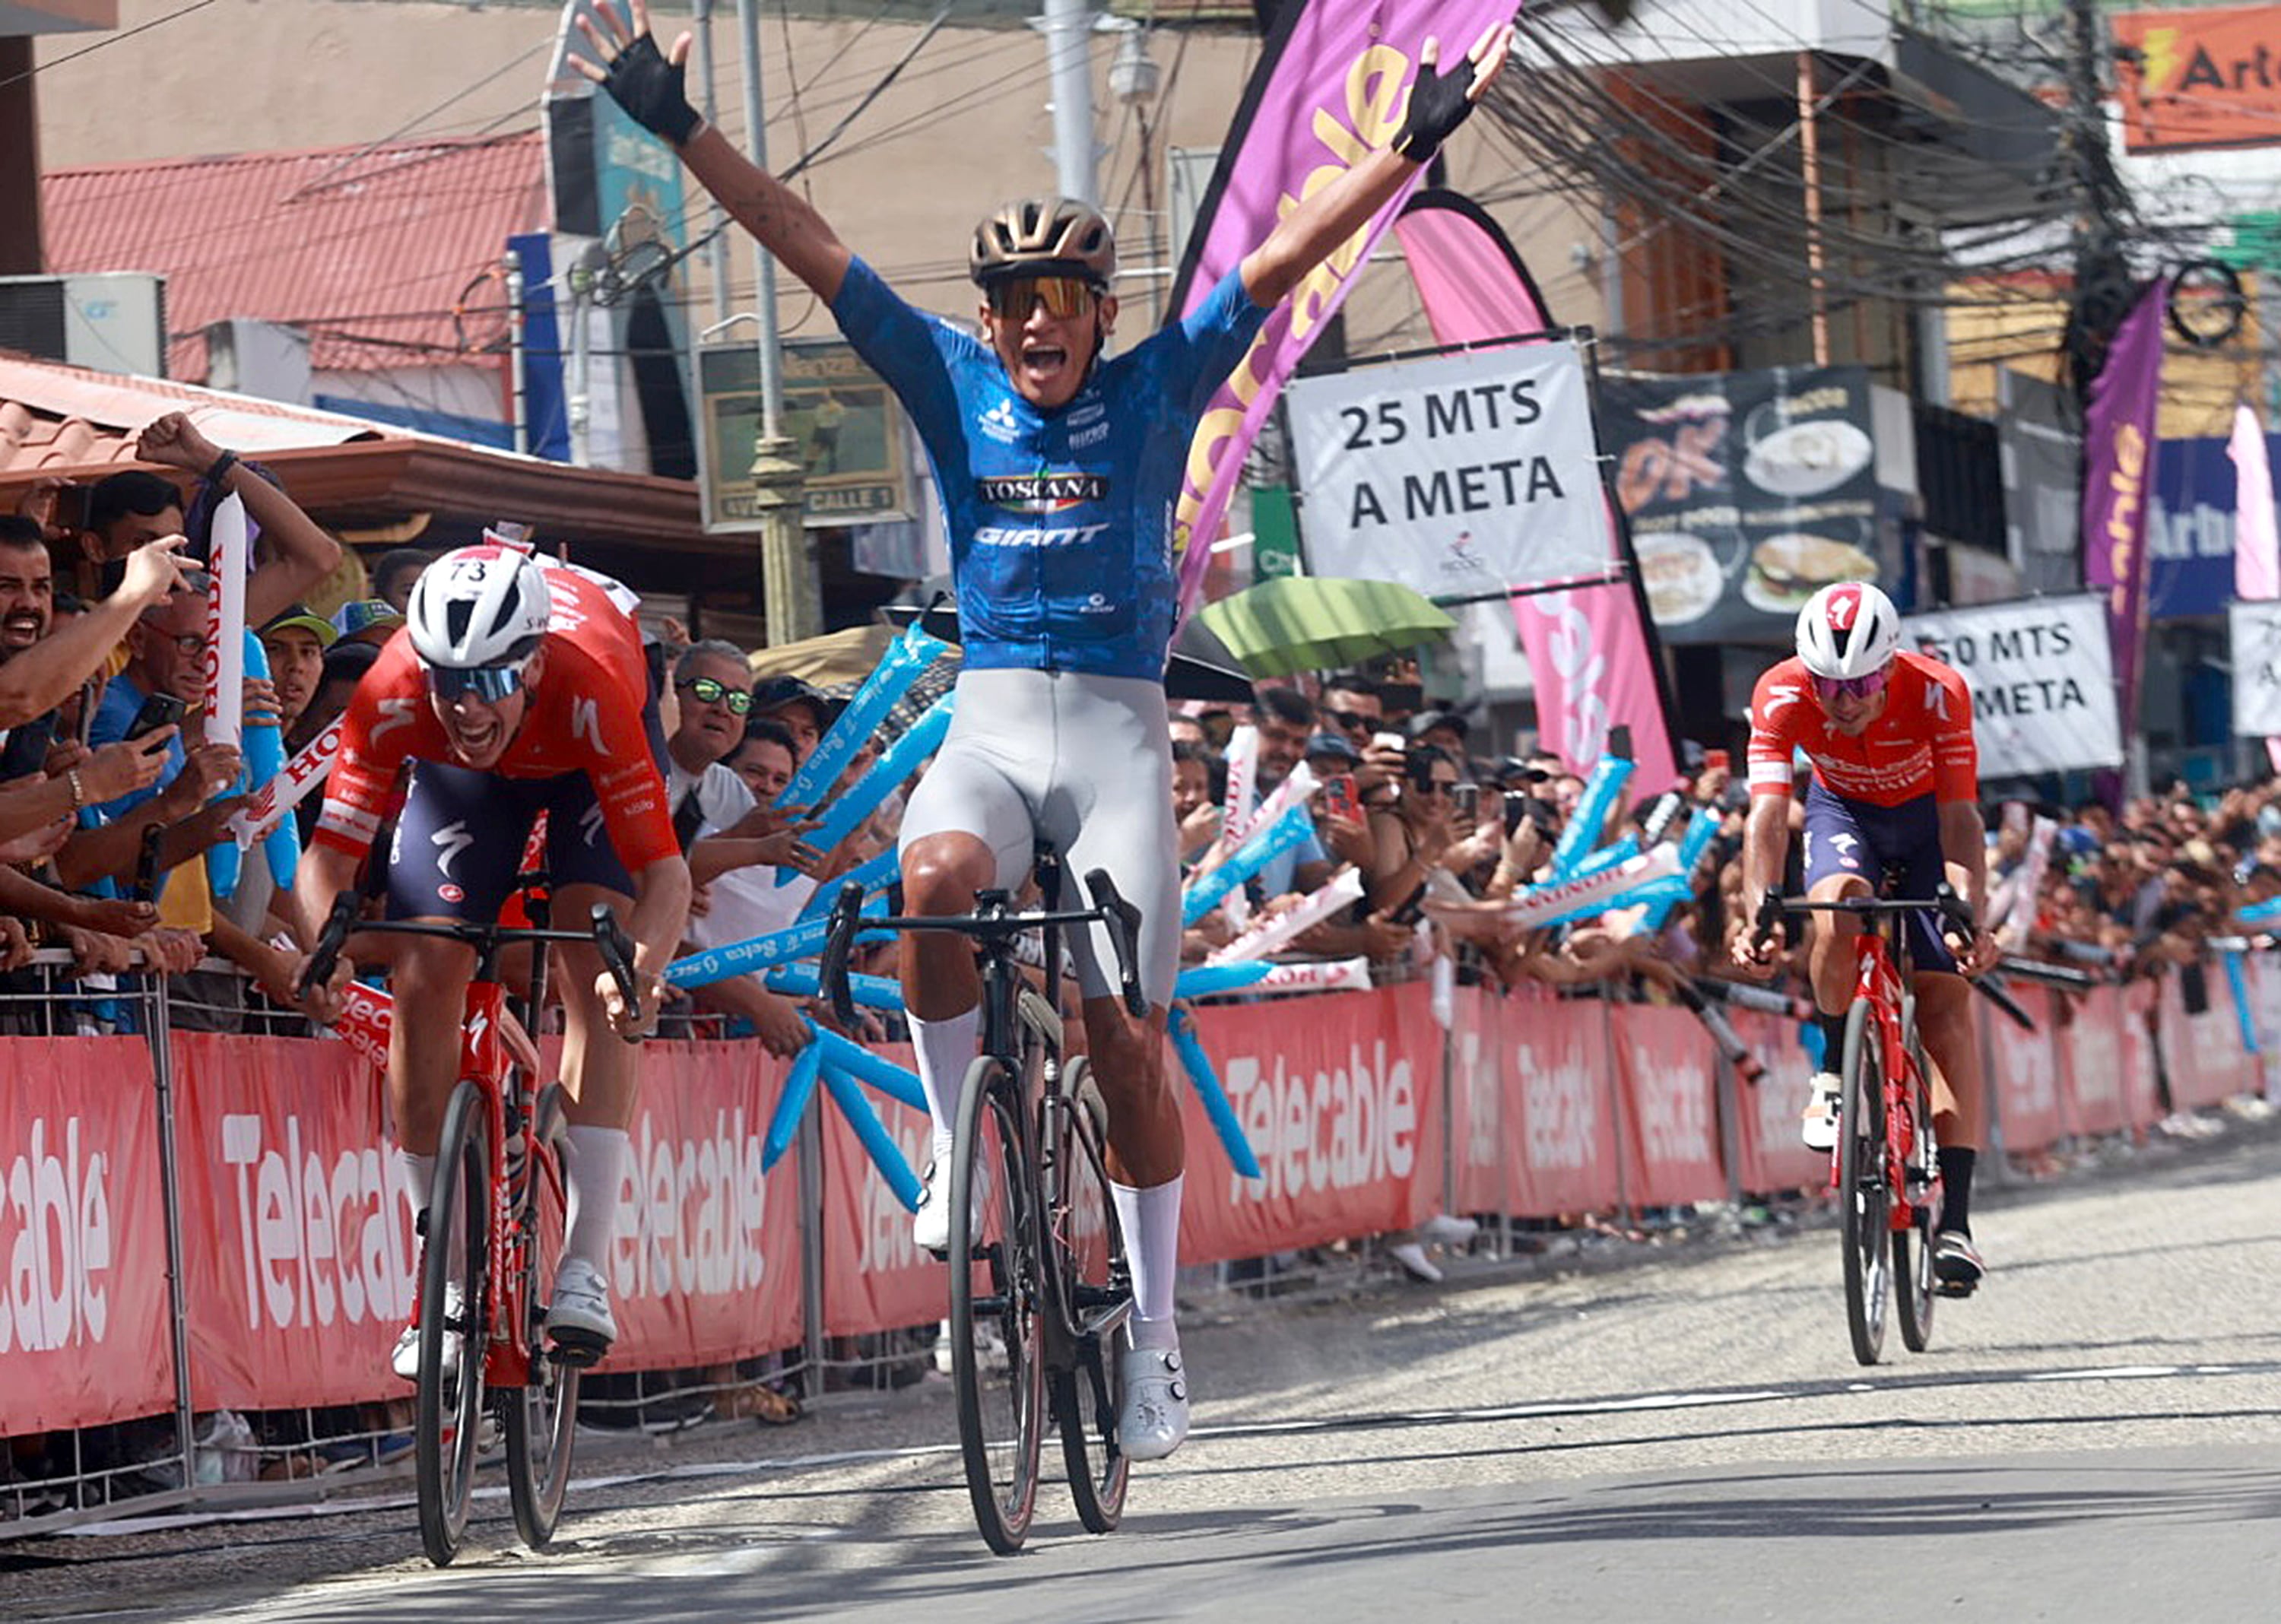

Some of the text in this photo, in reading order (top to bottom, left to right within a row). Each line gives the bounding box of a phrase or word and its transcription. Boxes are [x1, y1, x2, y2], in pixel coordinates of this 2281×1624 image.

[1340, 379, 1541, 450] 25 MTS
[981, 478, 1102, 498] TOSCANA
[1350, 481, 1388, 529] A
[1404, 455, 1566, 521] META
[972, 523, 1111, 547] GIANT
[450, 561, 487, 582] 73
[204, 543, 224, 718] HONDA
[1991, 622, 2071, 661] MTS
[1226, 1039, 1416, 1205] Telecable
